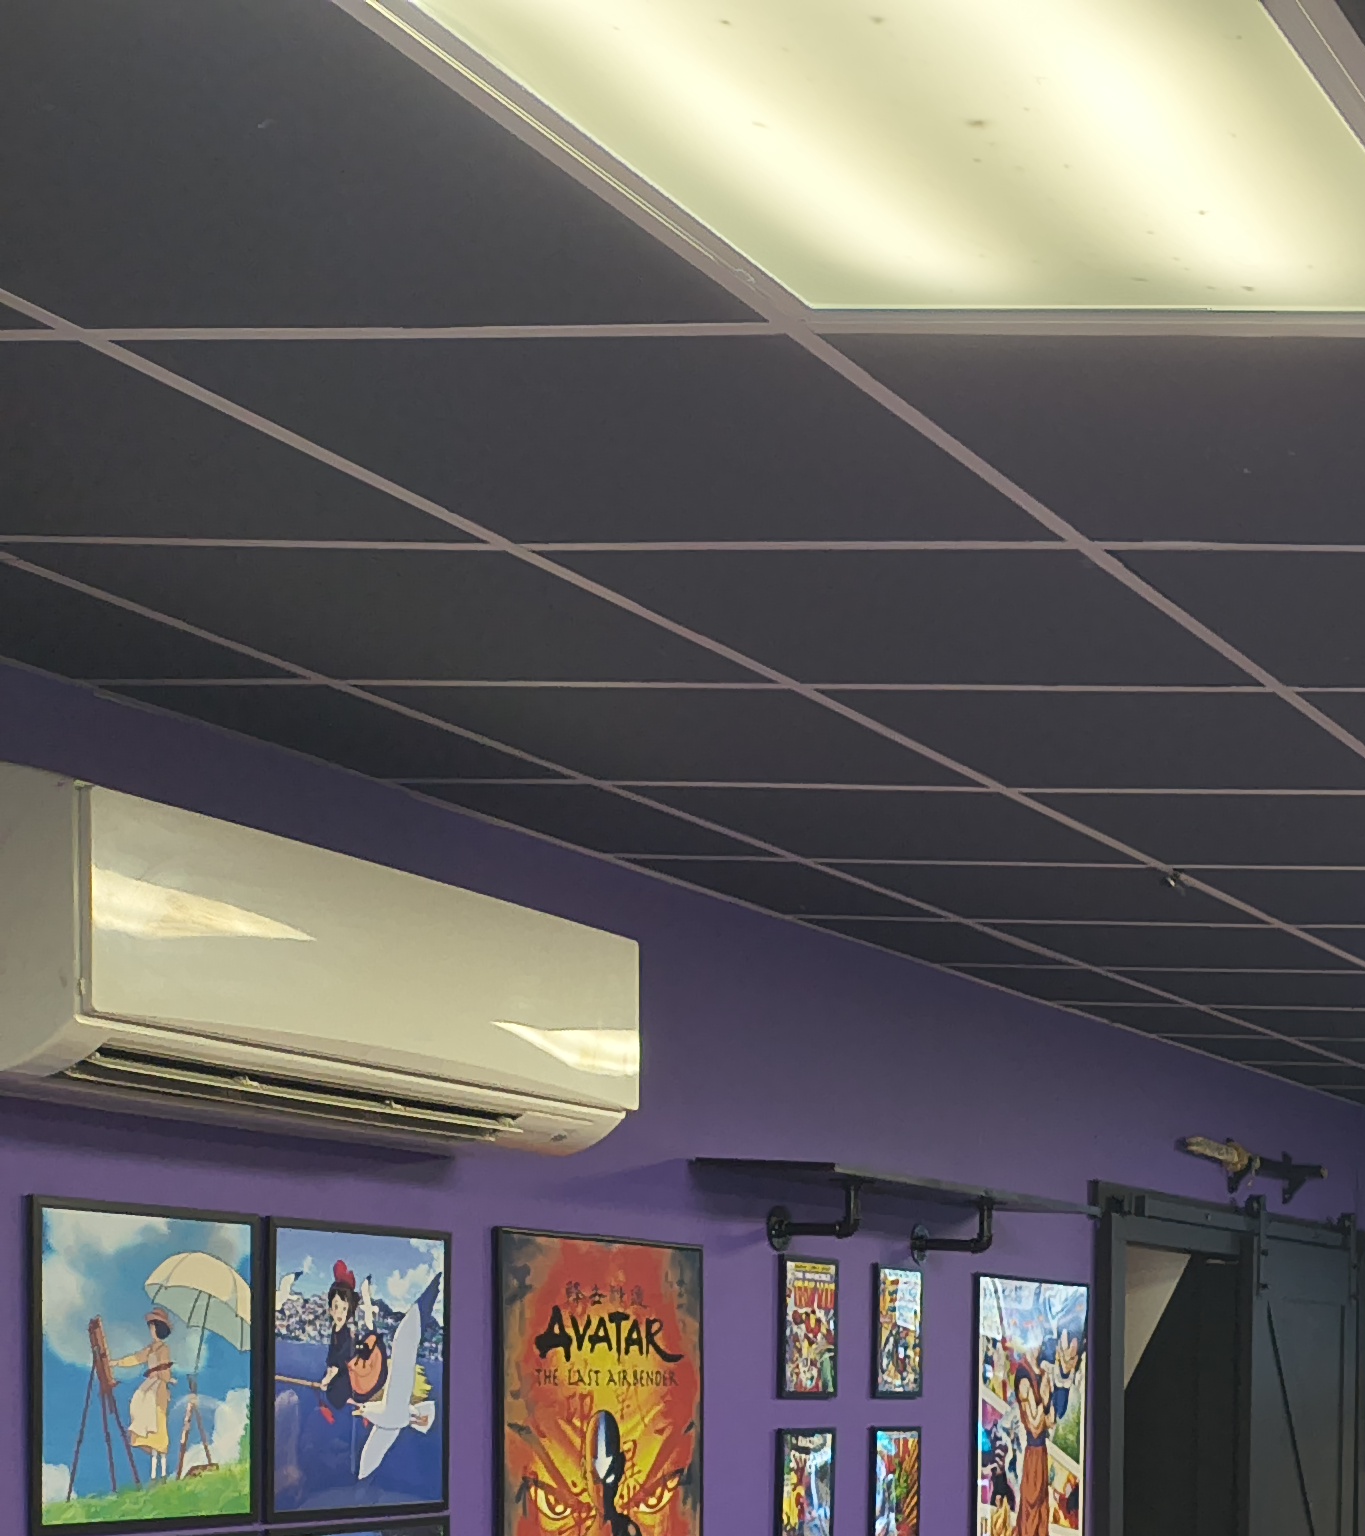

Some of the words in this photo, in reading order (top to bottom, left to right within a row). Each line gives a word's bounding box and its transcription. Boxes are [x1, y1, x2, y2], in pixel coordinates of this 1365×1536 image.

[534, 1304, 684, 1364] AVATAR
[535, 1368, 559, 1387] THE
[567, 1368, 602, 1387] LAST
[606, 1368, 679, 1387] AIRBENDER
